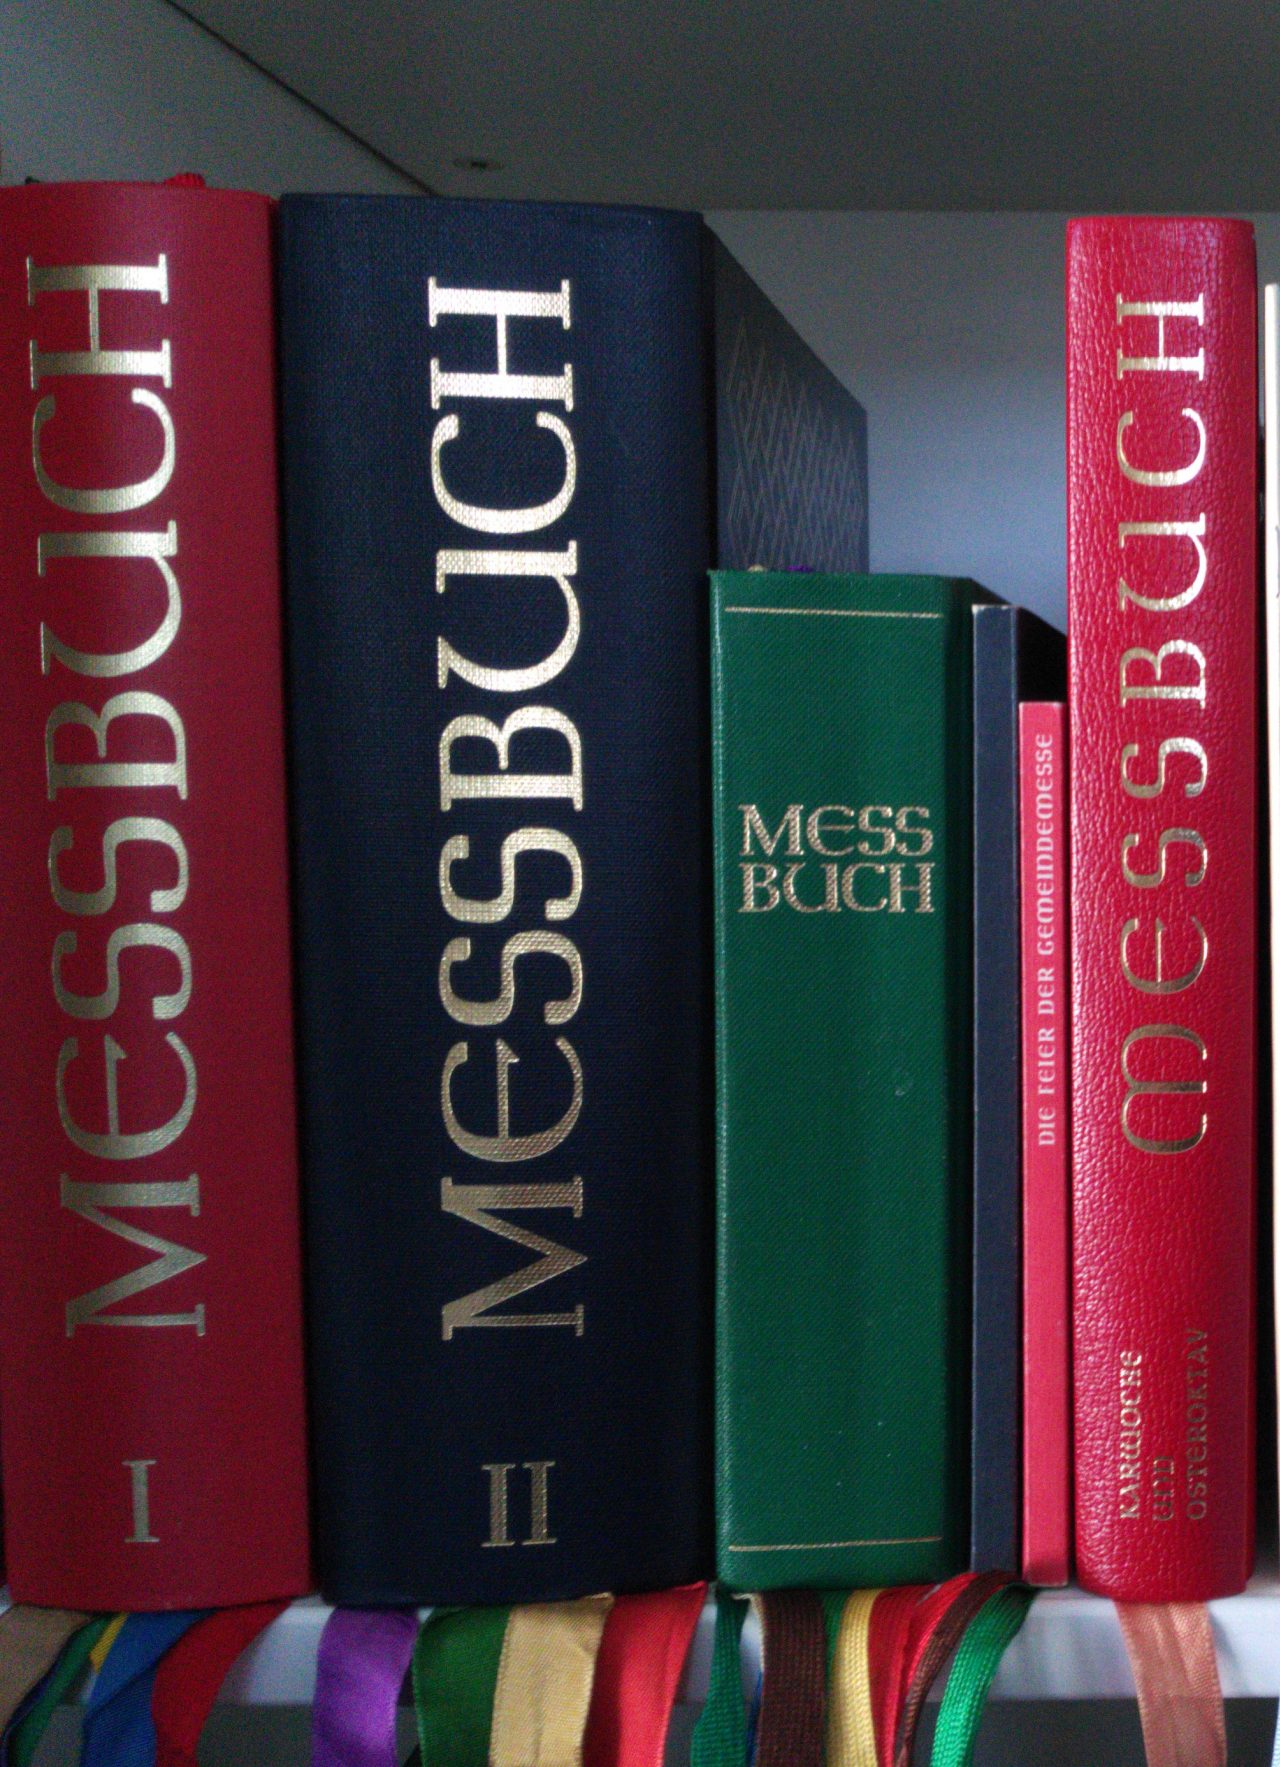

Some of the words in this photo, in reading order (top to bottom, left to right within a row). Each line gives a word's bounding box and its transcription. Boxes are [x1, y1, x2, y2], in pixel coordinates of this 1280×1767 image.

[1116, 292, 1208, 1156] MESSBUCH
[26, 253, 207, 1338] MESSBUCH
[428, 275, 589, 1341] MESSBUCH
[737, 804, 935, 857] MESS
[1035, 733, 1055, 956] GEMEINDEMESSE
[736, 862, 936, 913] BUCH
[1036, 967, 1055, 1015] DER
[1036, 1027, 1056, 1095] FEIER
[1037, 1106, 1056, 1147] DIE
[1119, 1350, 1142, 1520] KARWOCHE
[1186, 1327, 1208, 1521] OSTEROKTAV
[122, 1459, 160, 1543] I
[481, 1461, 556, 1548] II
[1152, 1455, 1174, 1522] UND
